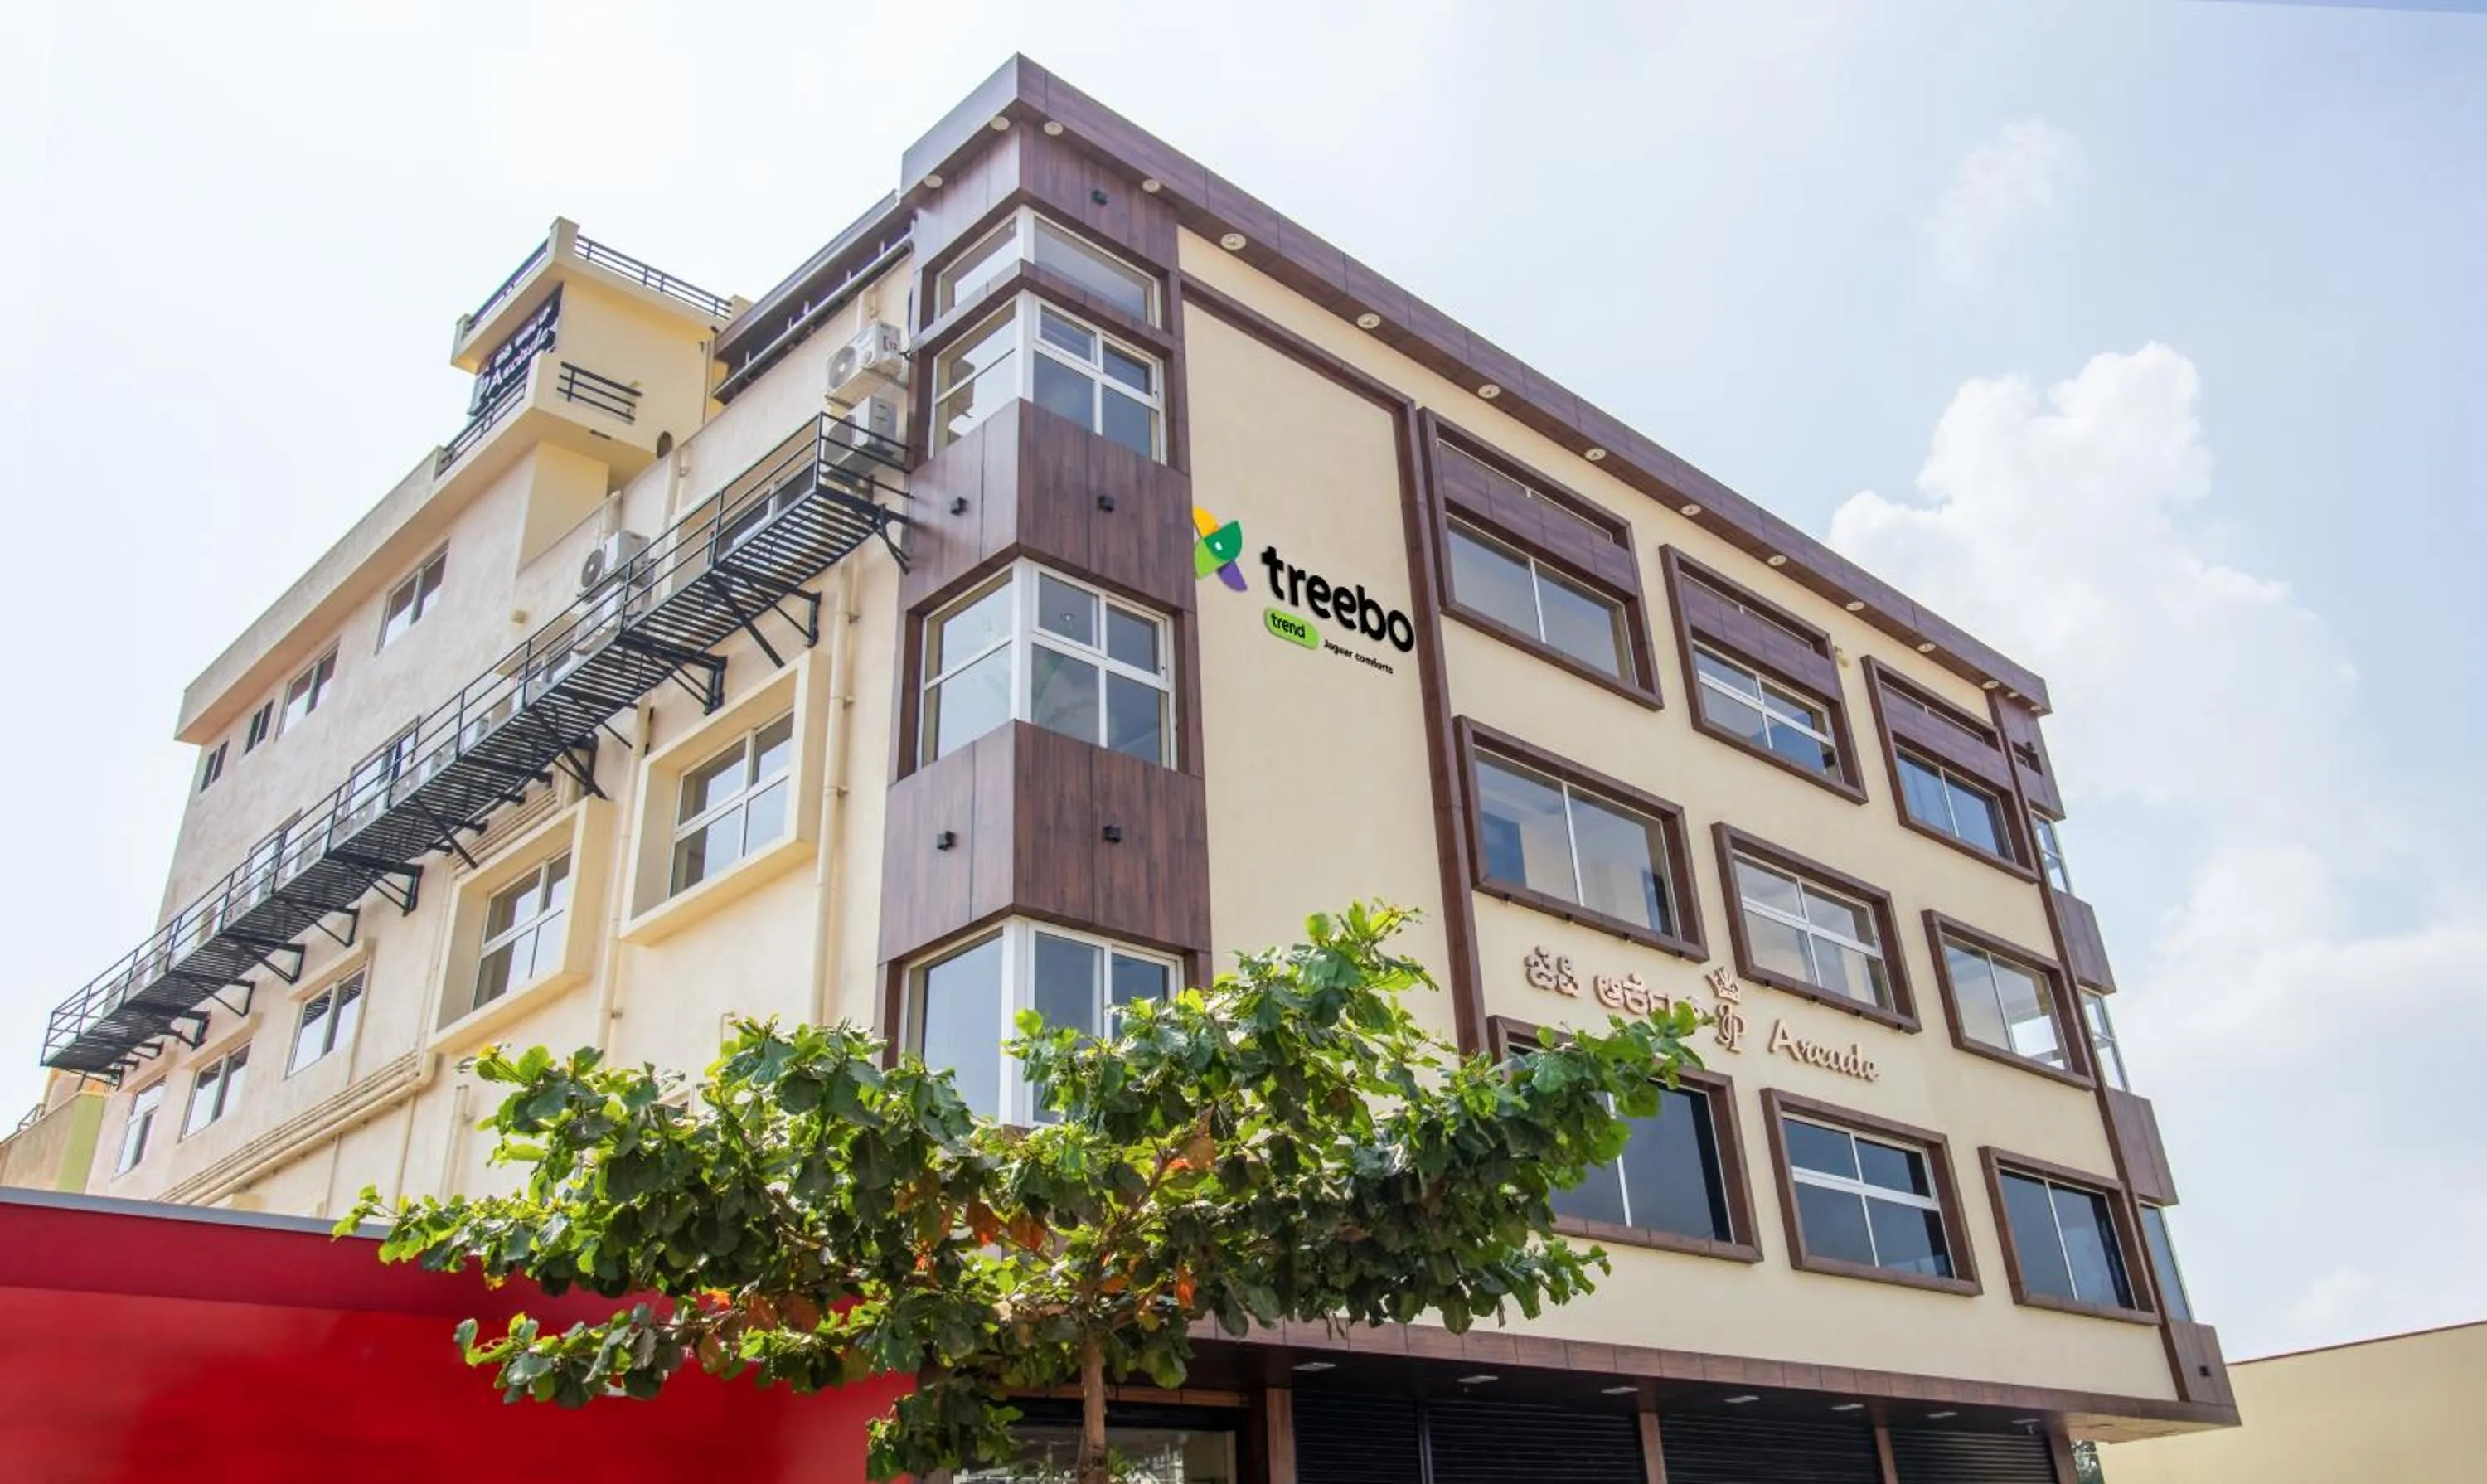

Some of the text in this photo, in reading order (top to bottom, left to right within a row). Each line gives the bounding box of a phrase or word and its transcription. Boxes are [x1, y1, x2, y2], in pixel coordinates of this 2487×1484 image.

[1261, 546, 1415, 652] treebo
[1270, 613, 1307, 639] trend
[1355, 651, 1394, 674] comforts
[1767, 1018, 1880, 1082] Arcade
